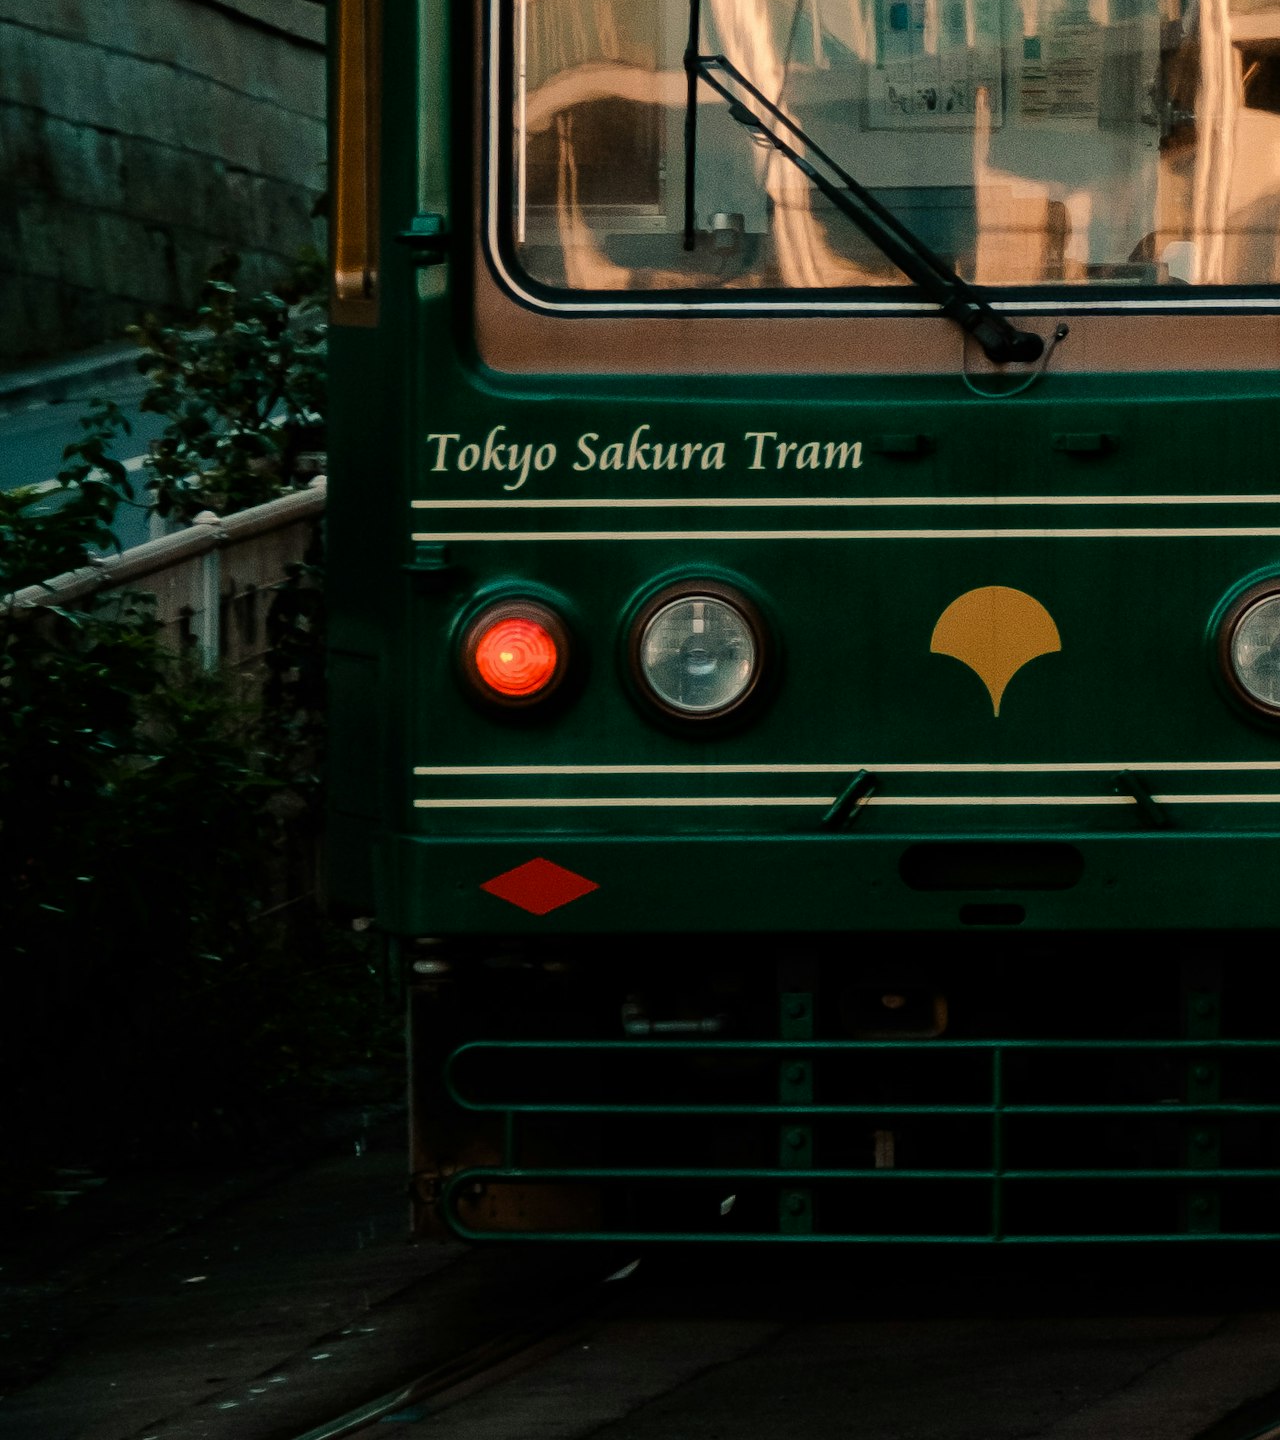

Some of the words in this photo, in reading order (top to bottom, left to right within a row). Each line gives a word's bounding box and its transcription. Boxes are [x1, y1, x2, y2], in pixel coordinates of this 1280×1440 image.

[428, 424, 556, 491] Tokyo
[572, 424, 725, 471] Sakura
[744, 431, 863, 470] Tram
